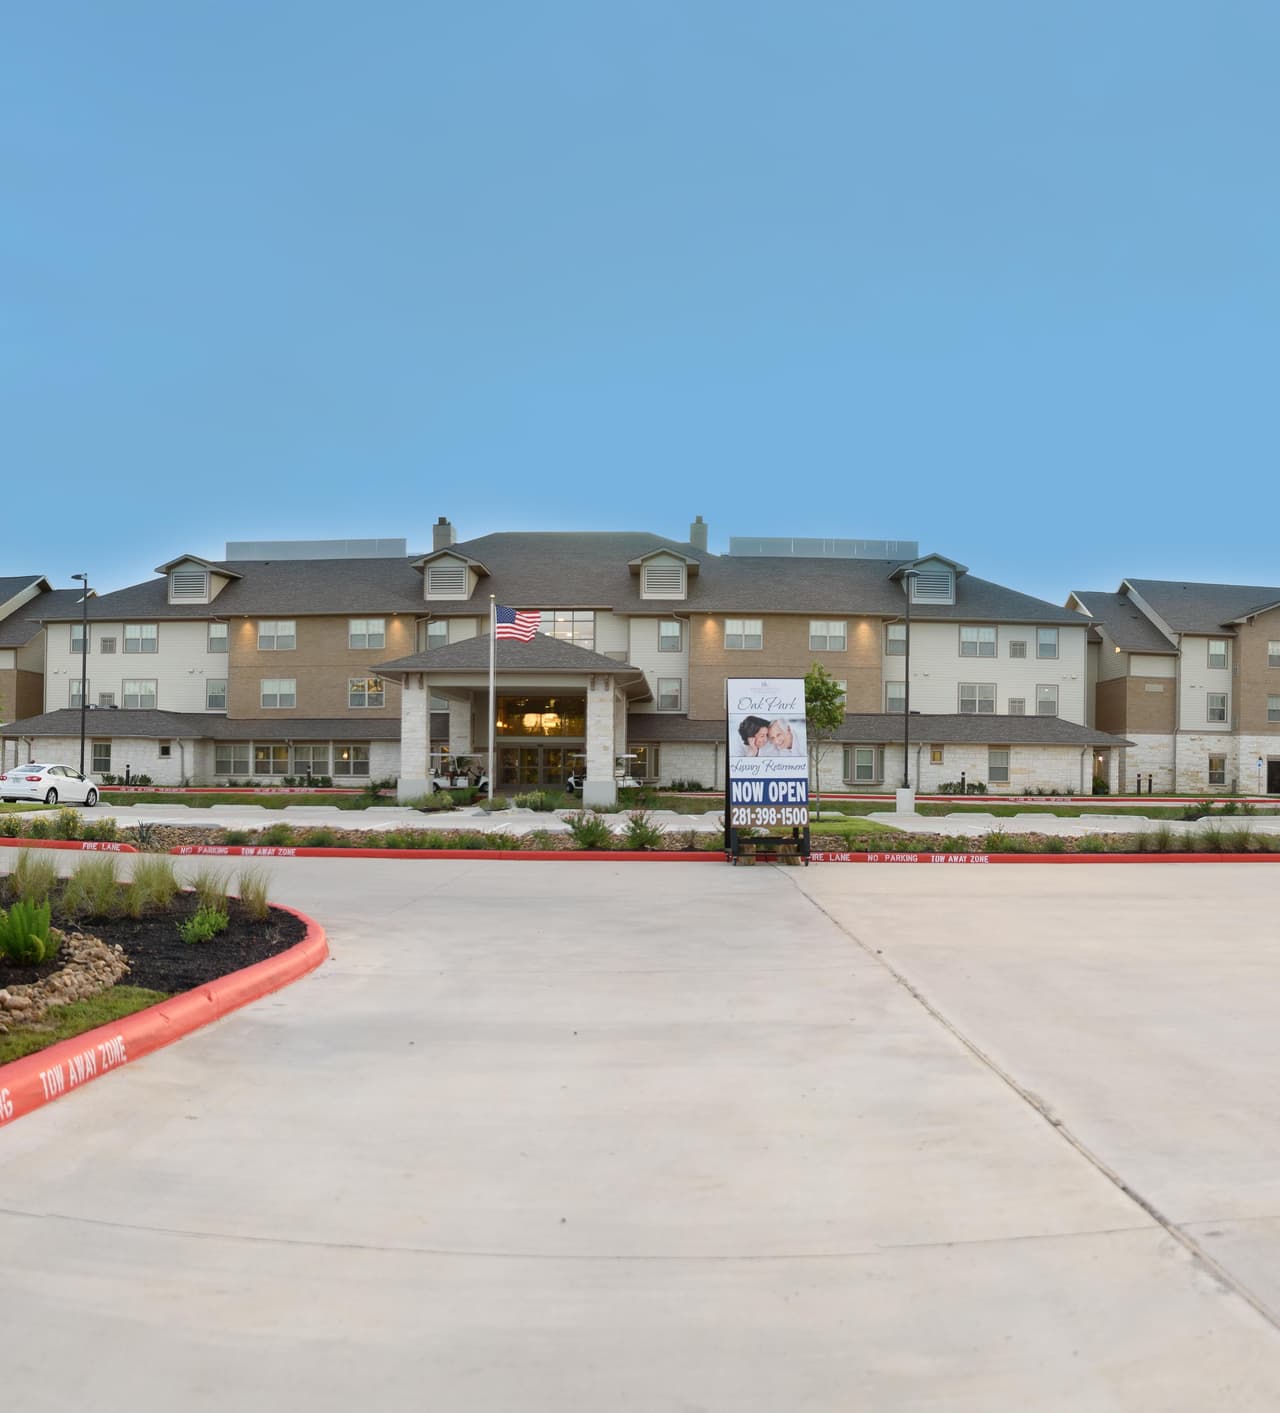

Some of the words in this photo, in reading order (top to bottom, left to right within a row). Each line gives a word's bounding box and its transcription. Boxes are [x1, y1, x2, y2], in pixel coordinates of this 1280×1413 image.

[765, 696, 798, 711] Park
[761, 760, 807, 773] Retirement
[732, 781, 764, 803] NOW
[768, 781, 806, 803] OPEN
[732, 807, 808, 826] 281-398-1500
[82, 842, 99, 851] FIRE
[101, 842, 121, 852] LANE
[180, 846, 193, 855] NO
[197, 846, 229, 856] PARKING
[241, 847, 255, 856] TOW
[257, 847, 276, 857] AWAY
[278, 847, 297, 857] ZONE
[829, 853, 851, 862] LANE
[867, 854, 879, 862] NO
[884, 854, 918, 862] PARKING
[931, 855, 945, 863] TOW
[947, 855, 967, 863] AWAY
[969, 855, 990, 864] ZONE
[39, 1063, 66, 1101] TOW
[69, 1048, 98, 1087] AWAY
[97, 1034, 128, 1074] ZONE
